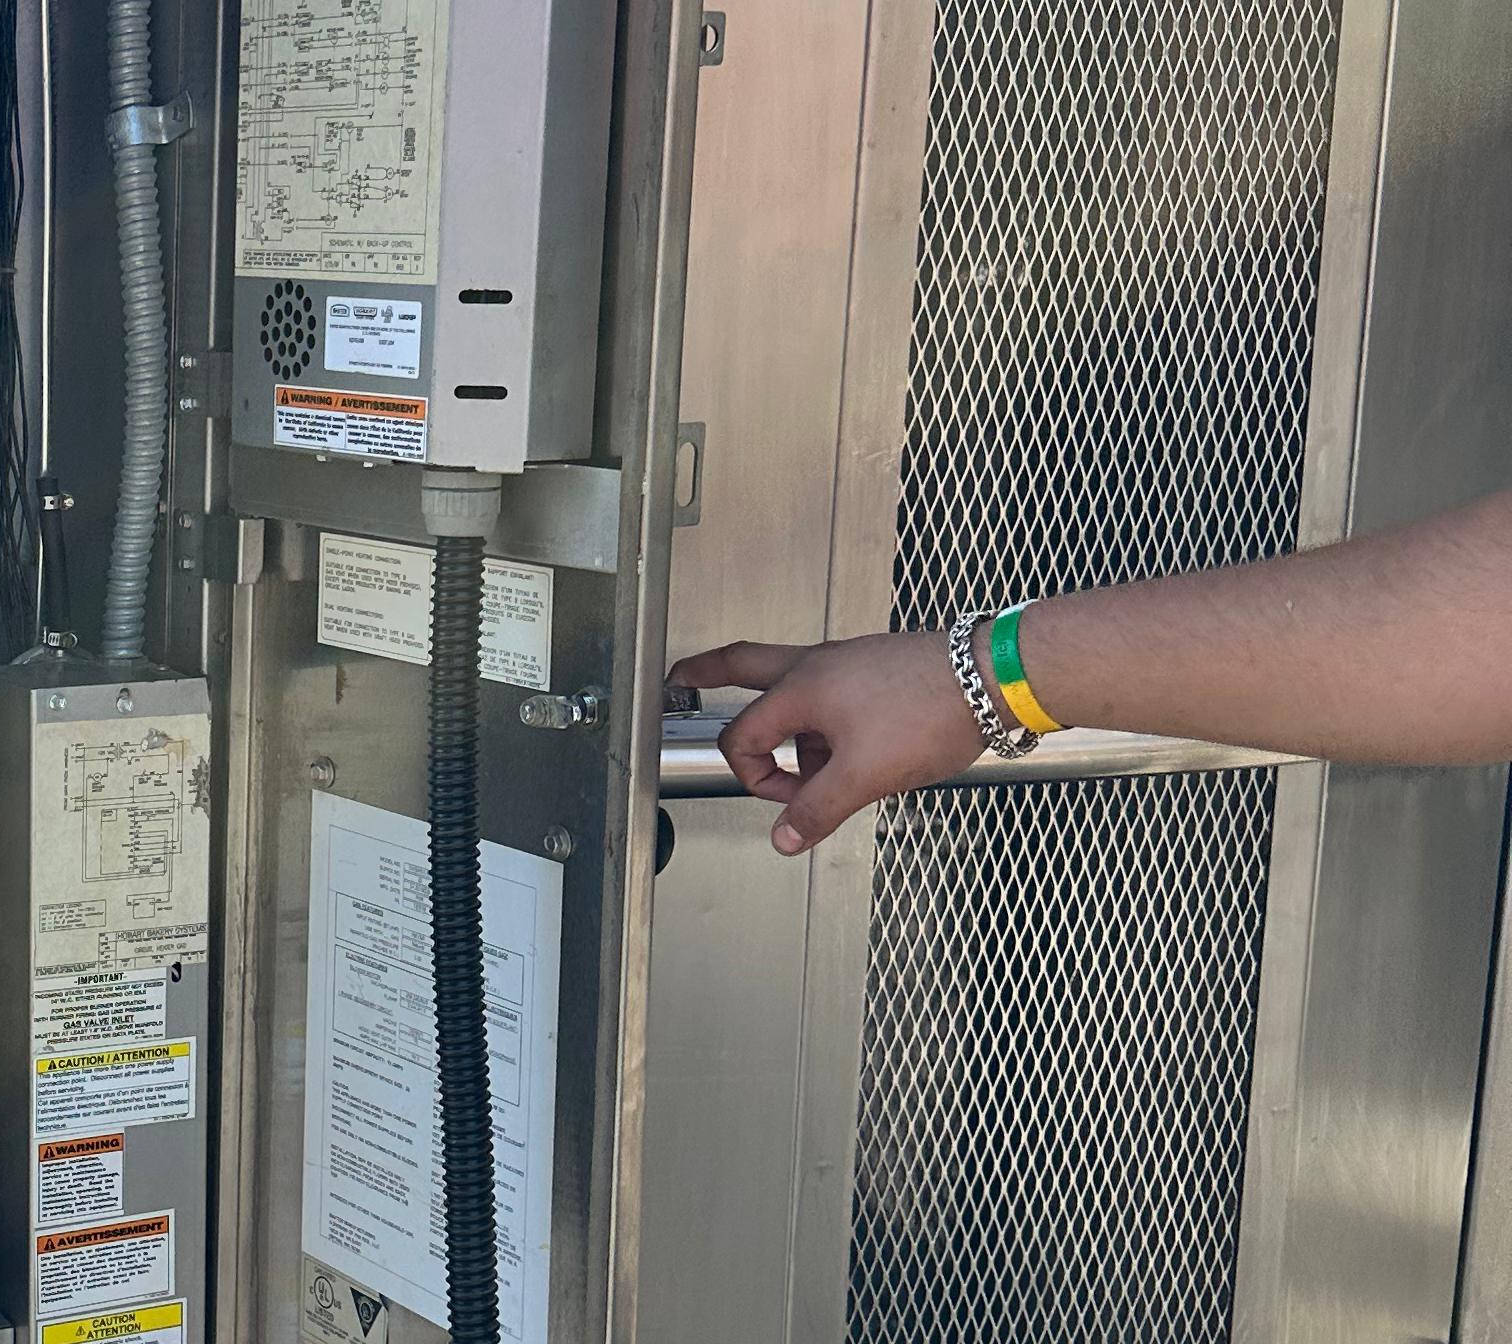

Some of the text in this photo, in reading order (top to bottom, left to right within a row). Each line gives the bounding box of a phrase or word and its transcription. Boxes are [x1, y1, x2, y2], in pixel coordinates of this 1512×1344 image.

[63, 1015, 133, 1028] GAS VALVE INLET
[58, 1046, 169, 1069] CAUTION / ATTENTION
[55, 1137, 119, 1155] WARNING
[57, 1221, 163, 1246] AVERTISSEMENT
[92, 1314, 135, 1327] CAUTION
[86, 1322, 140, 1339] ATTENTION
